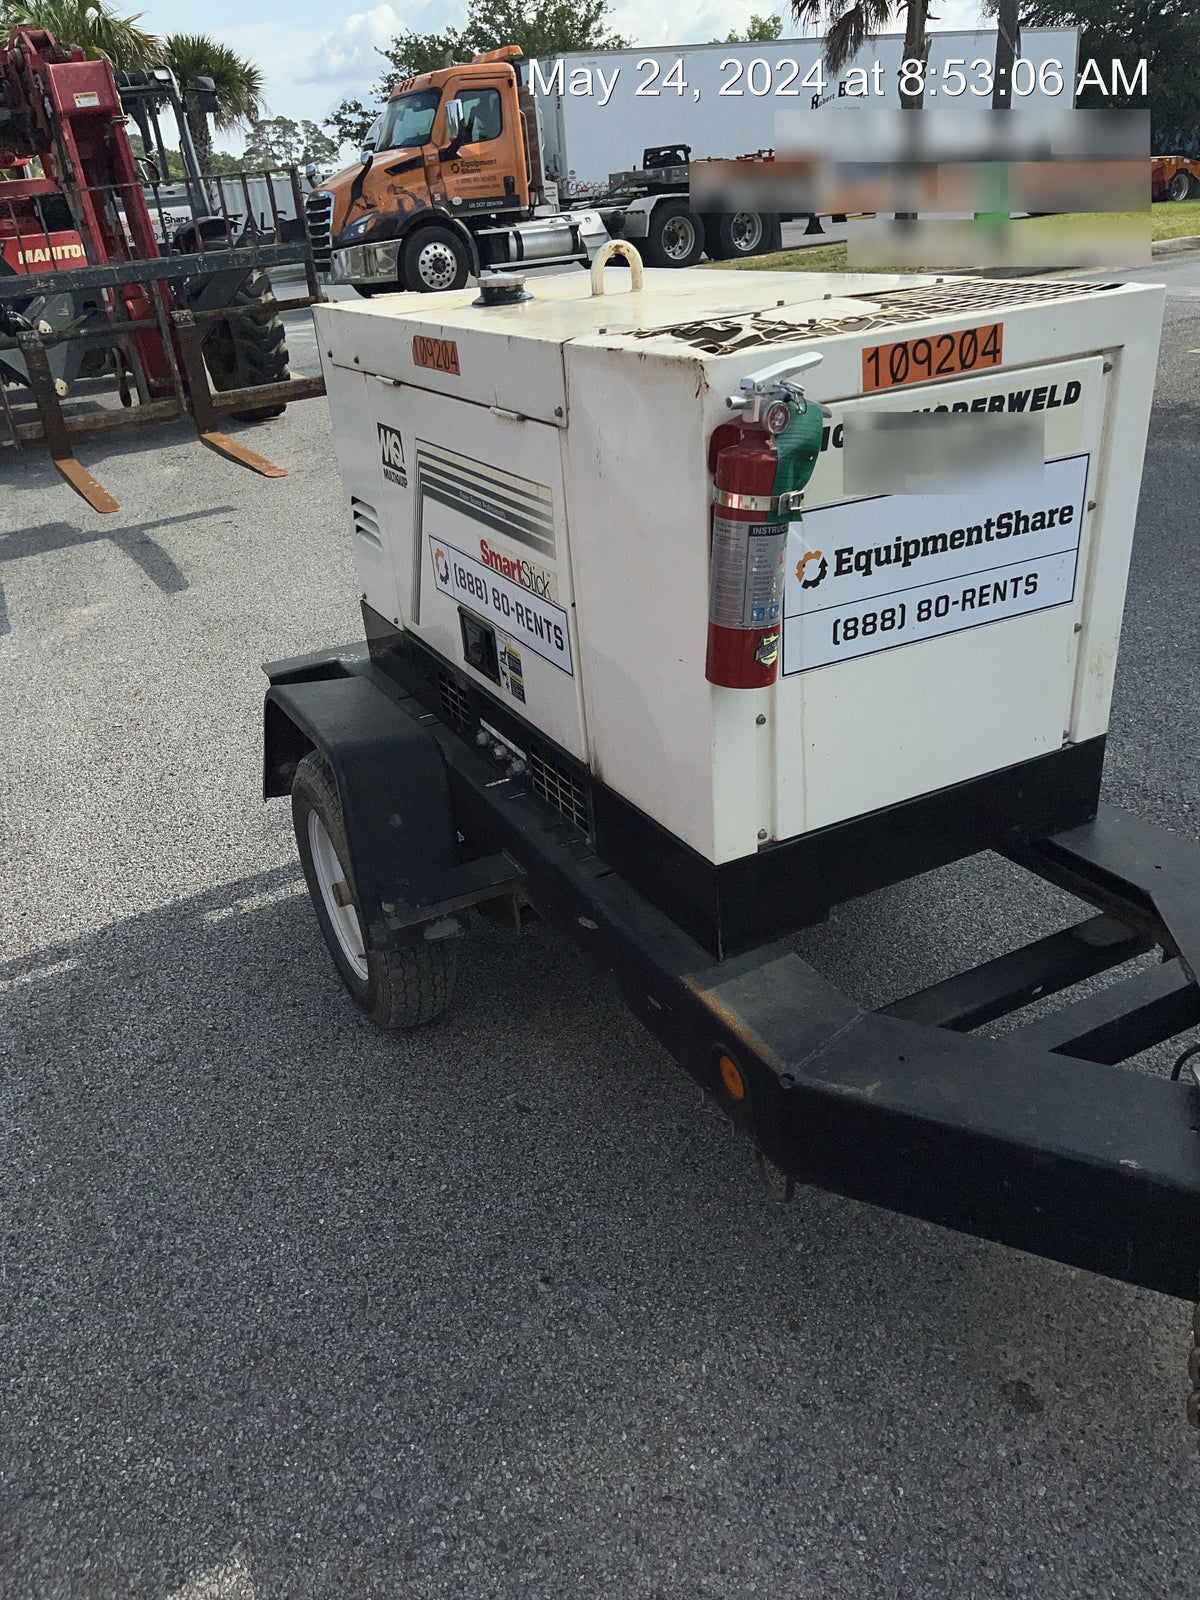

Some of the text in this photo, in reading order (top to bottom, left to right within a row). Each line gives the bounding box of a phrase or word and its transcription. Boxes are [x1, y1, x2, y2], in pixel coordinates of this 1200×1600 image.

[461, 158, 497, 167] Equipment
[413, 336, 459, 373] 109204
[866, 323, 1001, 387] 109204
[833, 504, 1074, 577] EquipmentShare
[453, 562, 565, 652] (888) 80-RENTS
[832, 572, 1039, 646] (888) 80-RENTS
